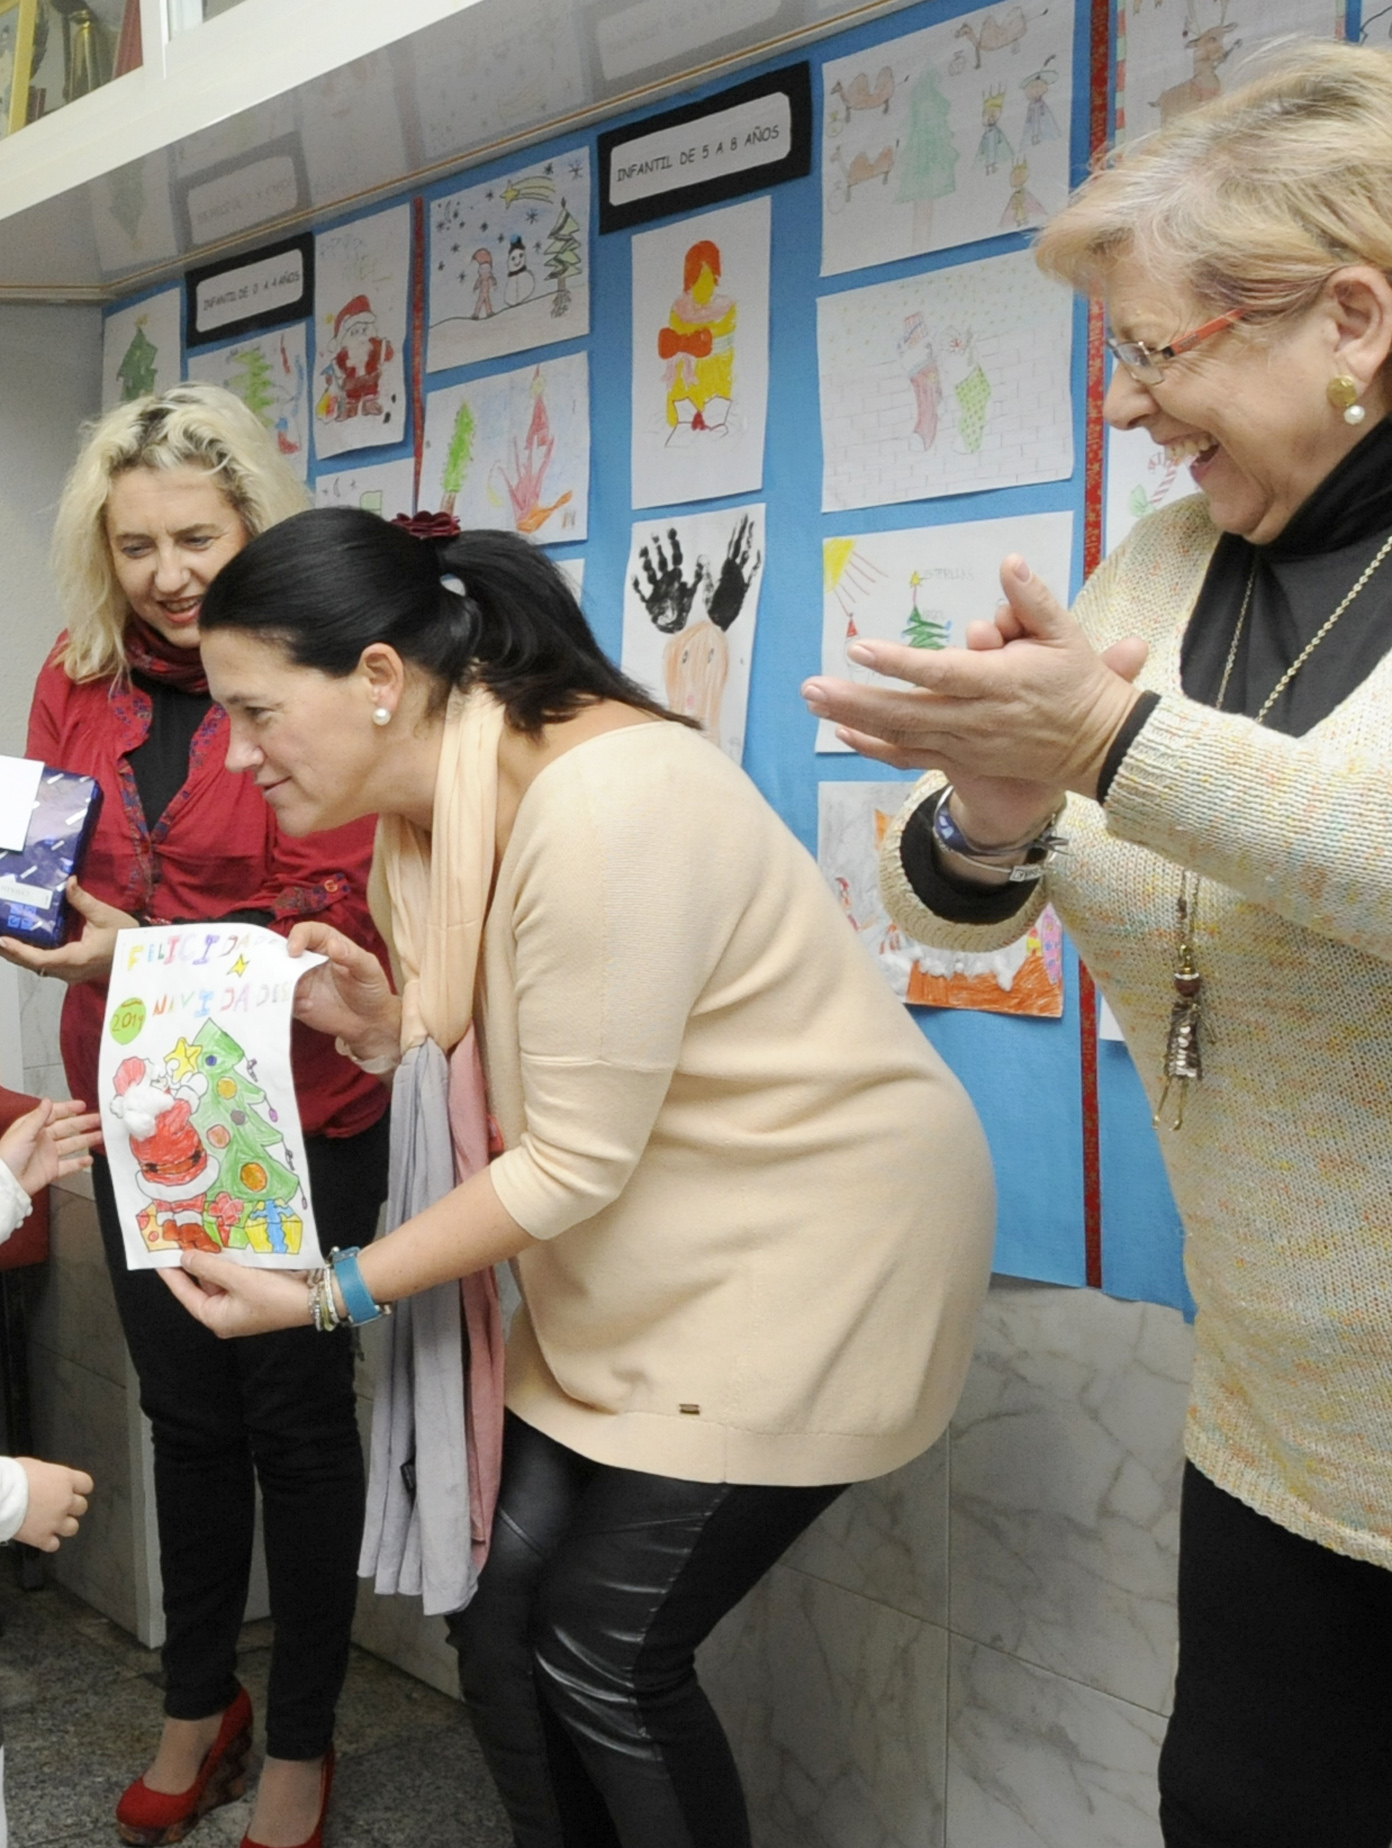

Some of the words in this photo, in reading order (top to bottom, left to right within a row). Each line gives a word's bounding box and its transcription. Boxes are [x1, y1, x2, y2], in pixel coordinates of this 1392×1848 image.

[617, 155, 673, 182] INFANTIL
[679, 147, 696, 166] DE
[702, 144, 710, 159] 5
[715, 141, 725, 155] A
[730, 136, 738, 151] 8
[744, 125, 780, 147] AÑOS
[203, 291, 237, 311] INFANTIL
[238, 285, 249, 300] DE
